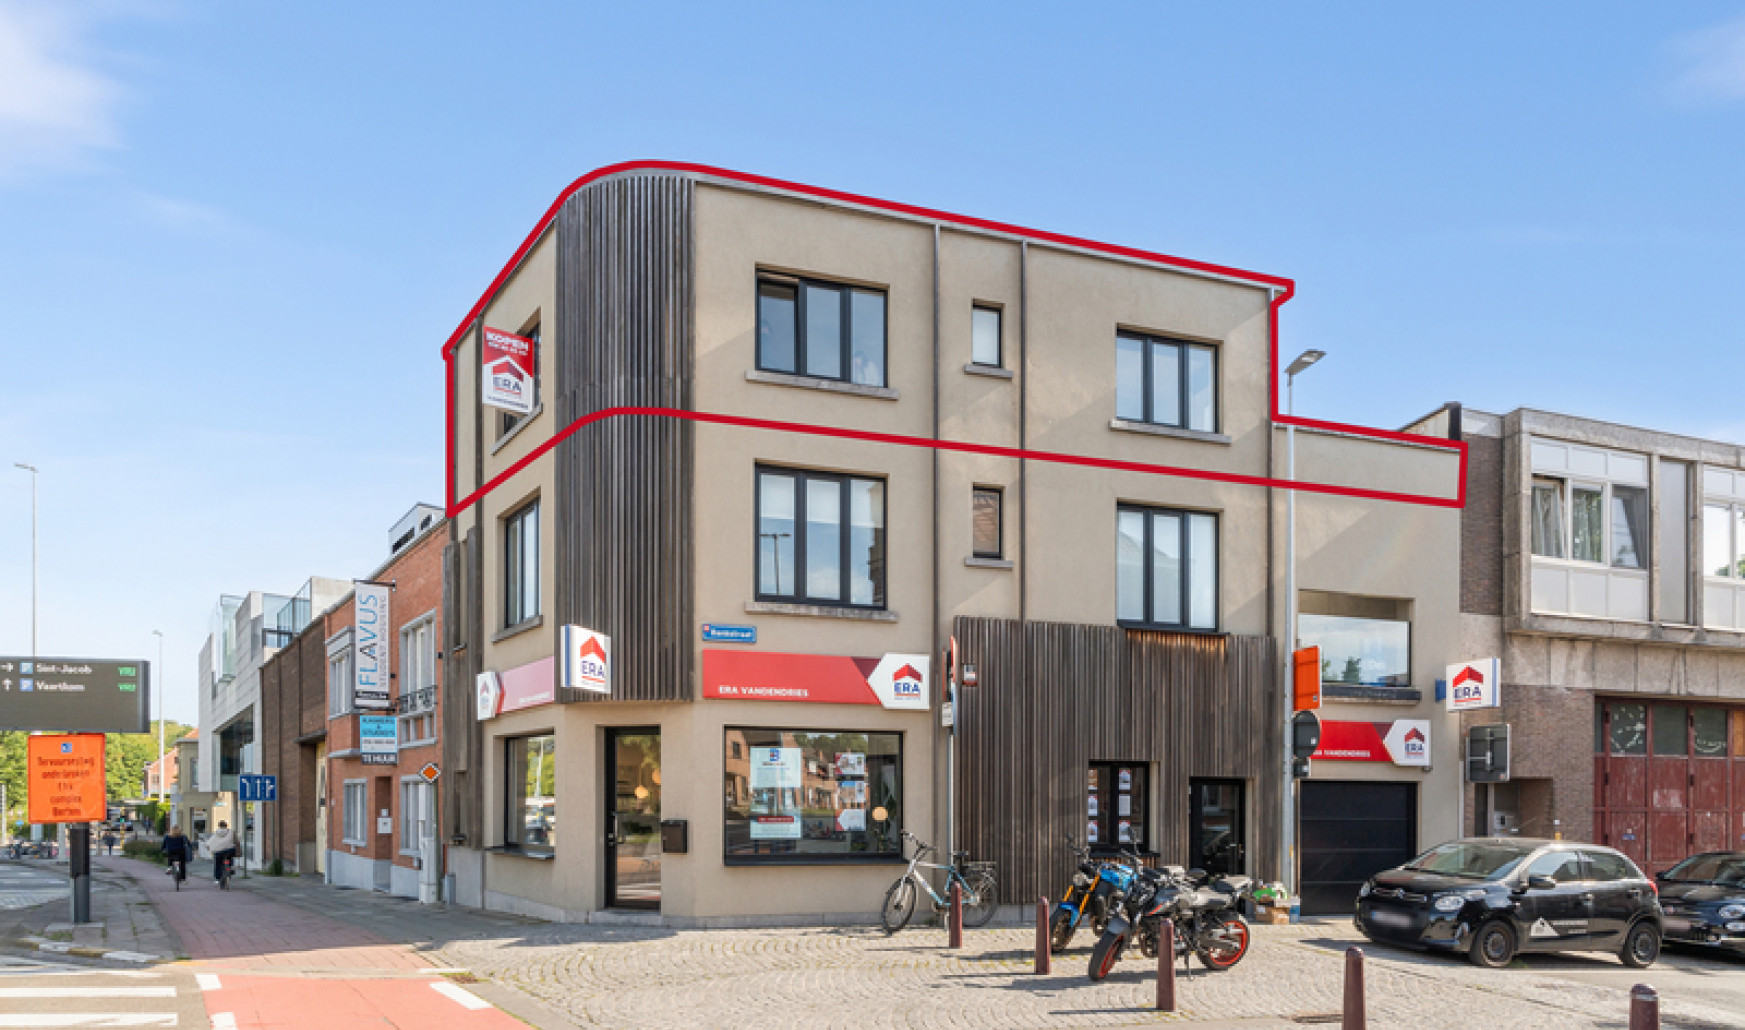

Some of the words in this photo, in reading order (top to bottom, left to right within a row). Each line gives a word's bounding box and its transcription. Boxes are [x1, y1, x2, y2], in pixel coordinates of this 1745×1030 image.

[493, 377, 521, 391] ERA
[358, 593, 378, 686] FLAVUS
[581, 660, 605, 677] ERA
[718, 686, 738, 694] ERA
[741, 686, 808, 697] VANDENDRIES
[894, 683, 920, 693] ERA
[1454, 686, 1482, 699] ERA
[1405, 742, 1424, 752] ERA
